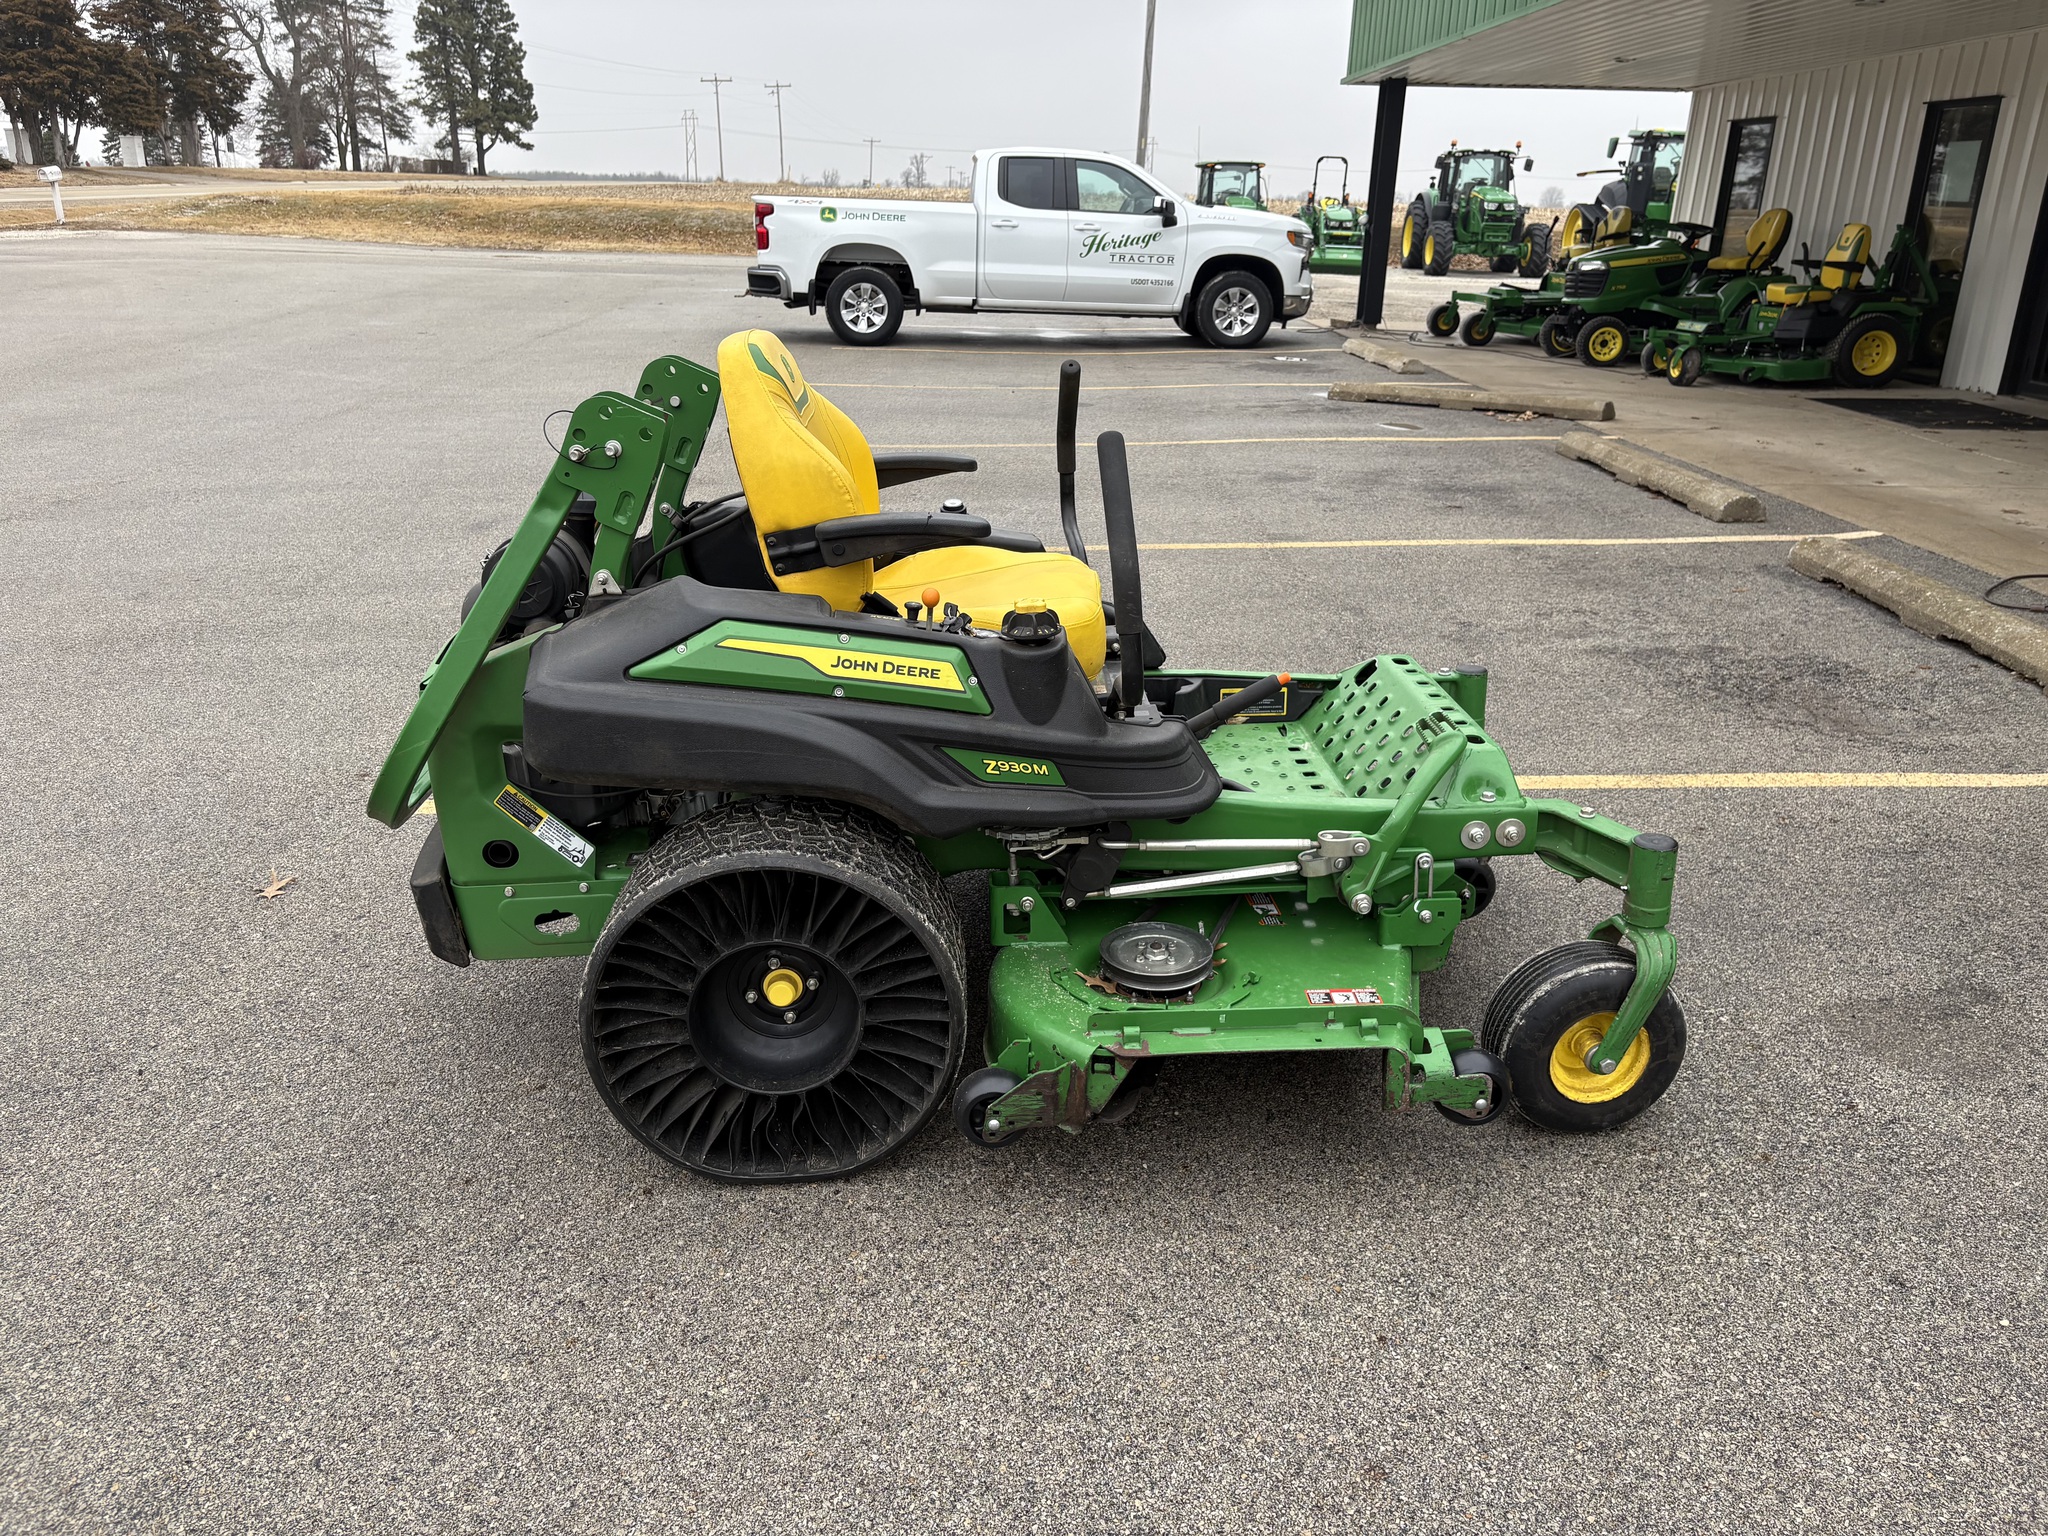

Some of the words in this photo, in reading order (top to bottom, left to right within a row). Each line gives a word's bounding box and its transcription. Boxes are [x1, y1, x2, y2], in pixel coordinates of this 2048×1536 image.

[841, 210, 870, 221] JOHN
[872, 211, 907, 222] DEERE
[1079, 231, 1163, 258] Heritage
[1109, 254, 1175, 264] TRACTOR
[1130, 278, 1149, 286] USDOT
[830, 655, 878, 673] JOHN
[882, 661, 941, 680] DEERE
[982, 759, 1049, 776] Z930M
[517, 794, 538, 812] CAUTION
